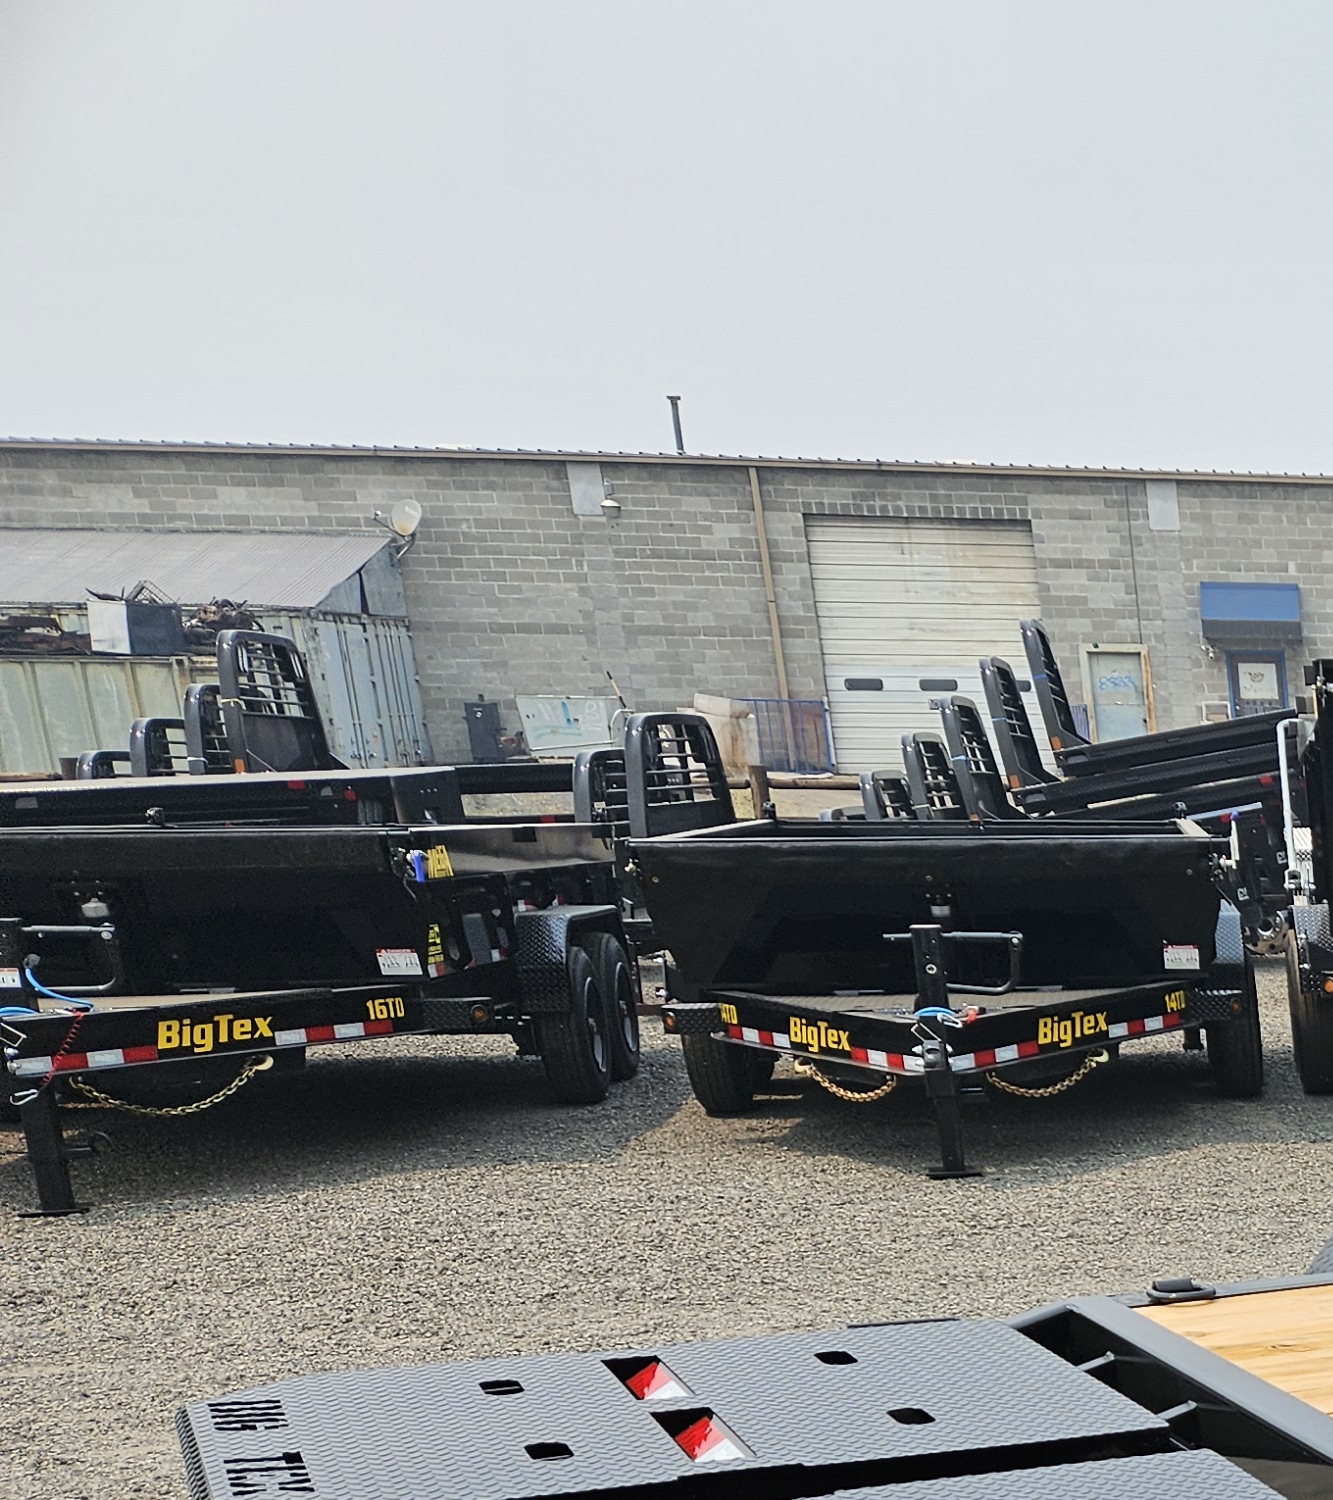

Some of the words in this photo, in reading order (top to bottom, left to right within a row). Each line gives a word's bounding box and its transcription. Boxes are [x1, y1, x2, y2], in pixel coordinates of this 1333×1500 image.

[366, 997, 405, 1020] 16TD
[158, 1013, 274, 1053] BigTex
[789, 1016, 851, 1053] BigTex
[1037, 1010, 1108, 1048] BigTex
